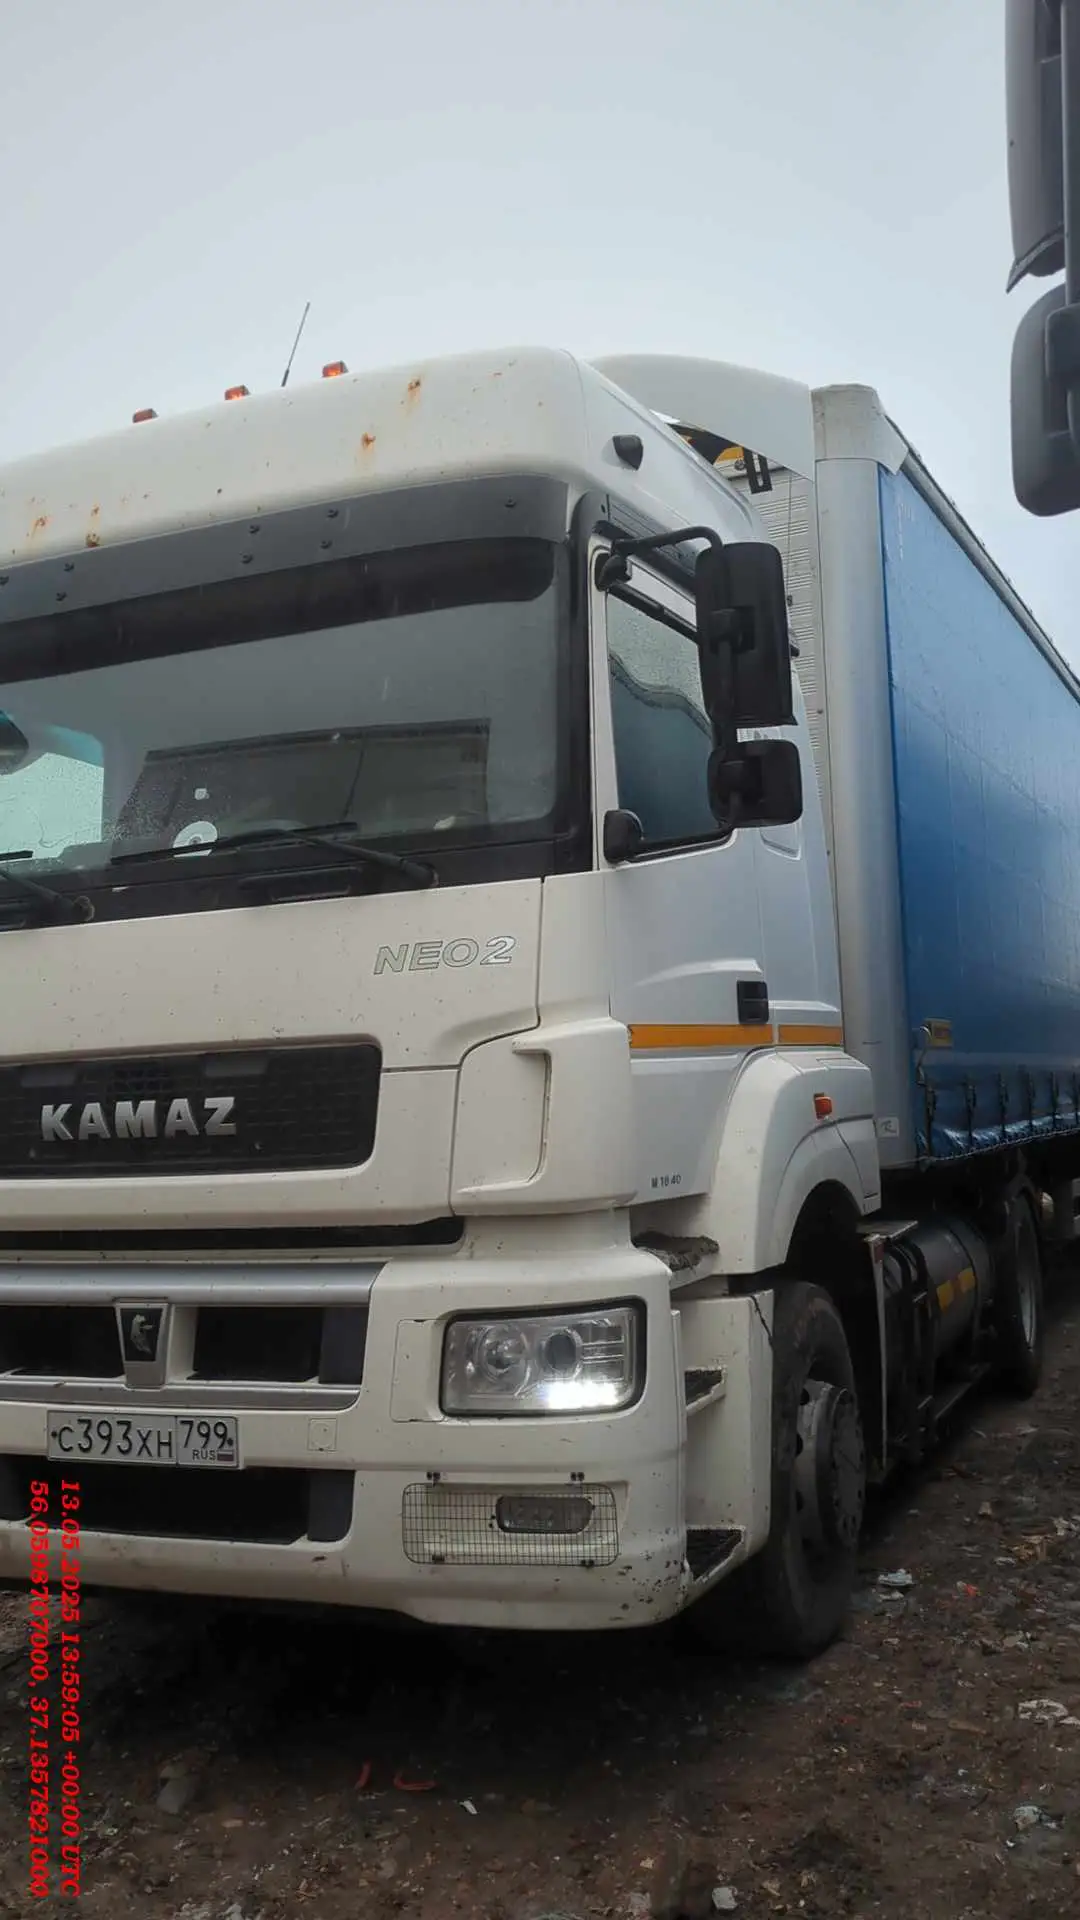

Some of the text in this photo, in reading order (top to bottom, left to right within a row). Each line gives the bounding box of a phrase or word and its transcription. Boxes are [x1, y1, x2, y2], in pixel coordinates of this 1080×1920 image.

[373, 935, 517, 975] NEO2
[41, 1096, 237, 1141] KAMAZ
[179, 1420, 229, 1450] 799
[192, 1450, 217, 1461] RUS
